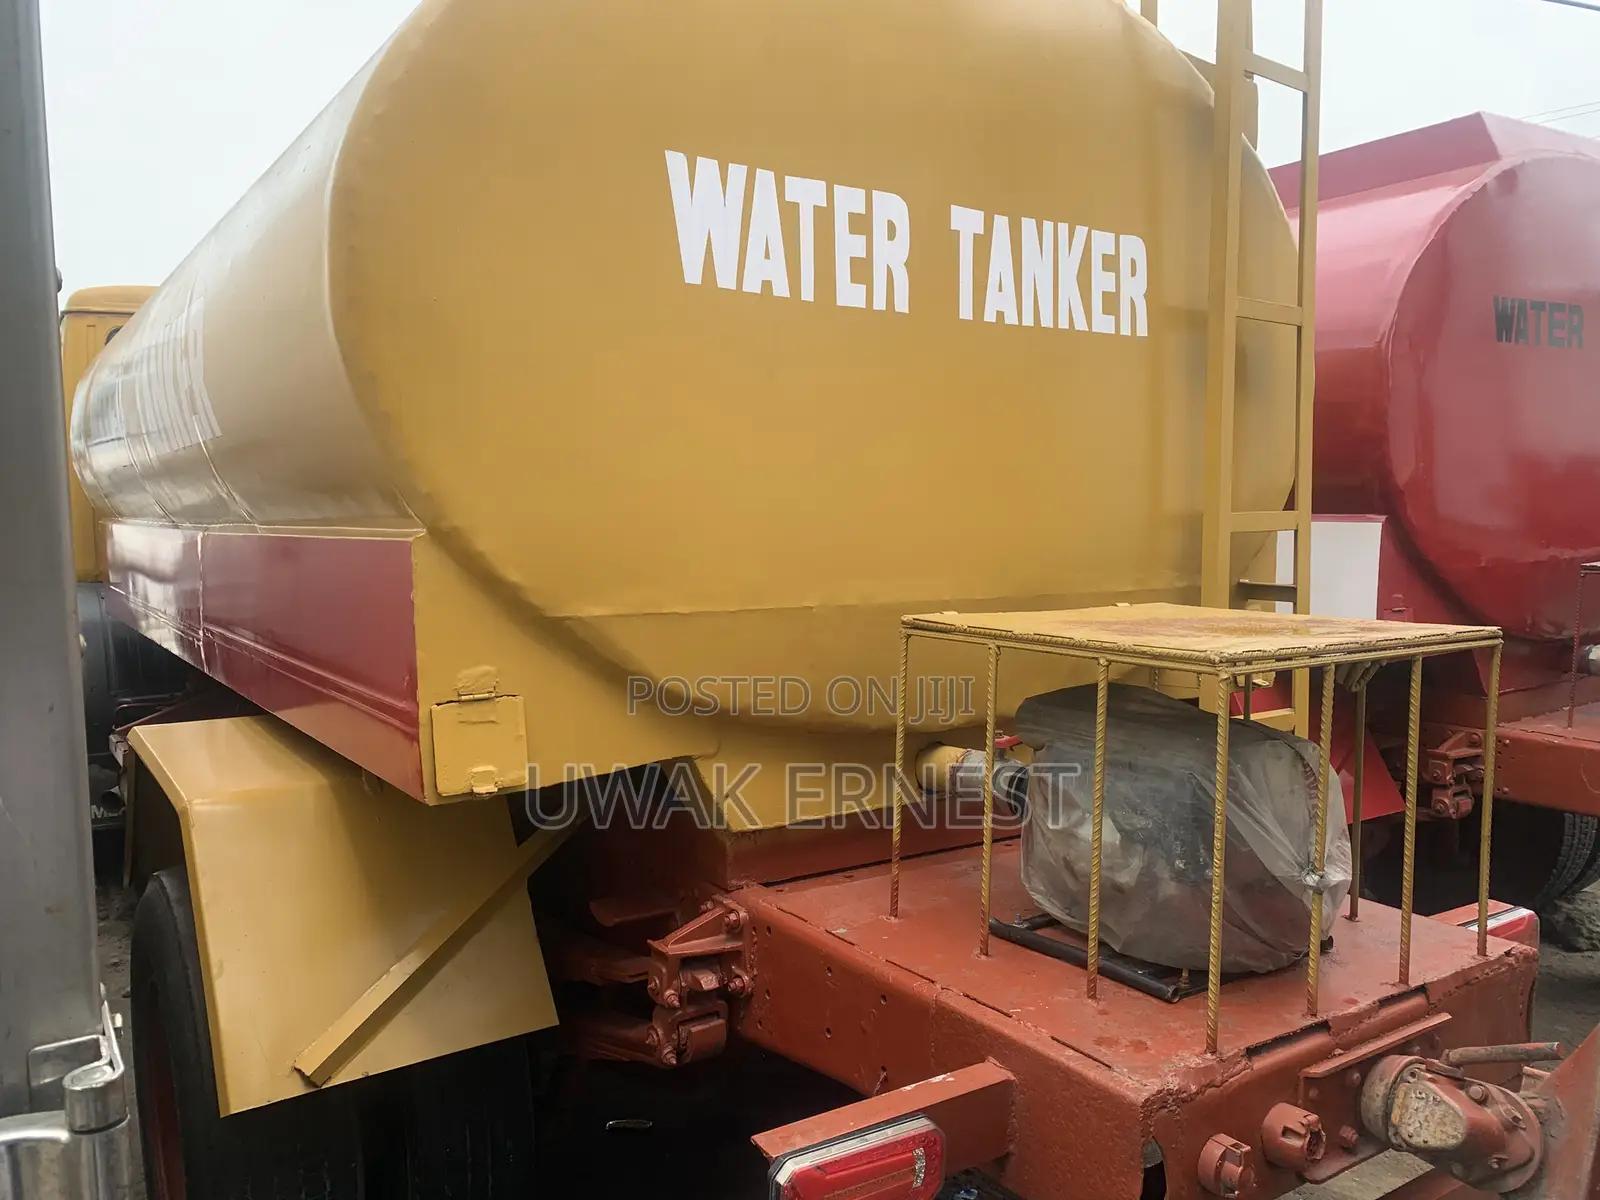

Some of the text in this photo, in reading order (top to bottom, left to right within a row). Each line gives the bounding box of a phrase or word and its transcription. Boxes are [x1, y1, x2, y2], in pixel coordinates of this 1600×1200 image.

[665, 150, 1148, 337] WATER TANKER
[1493, 296, 1584, 349] WATER
